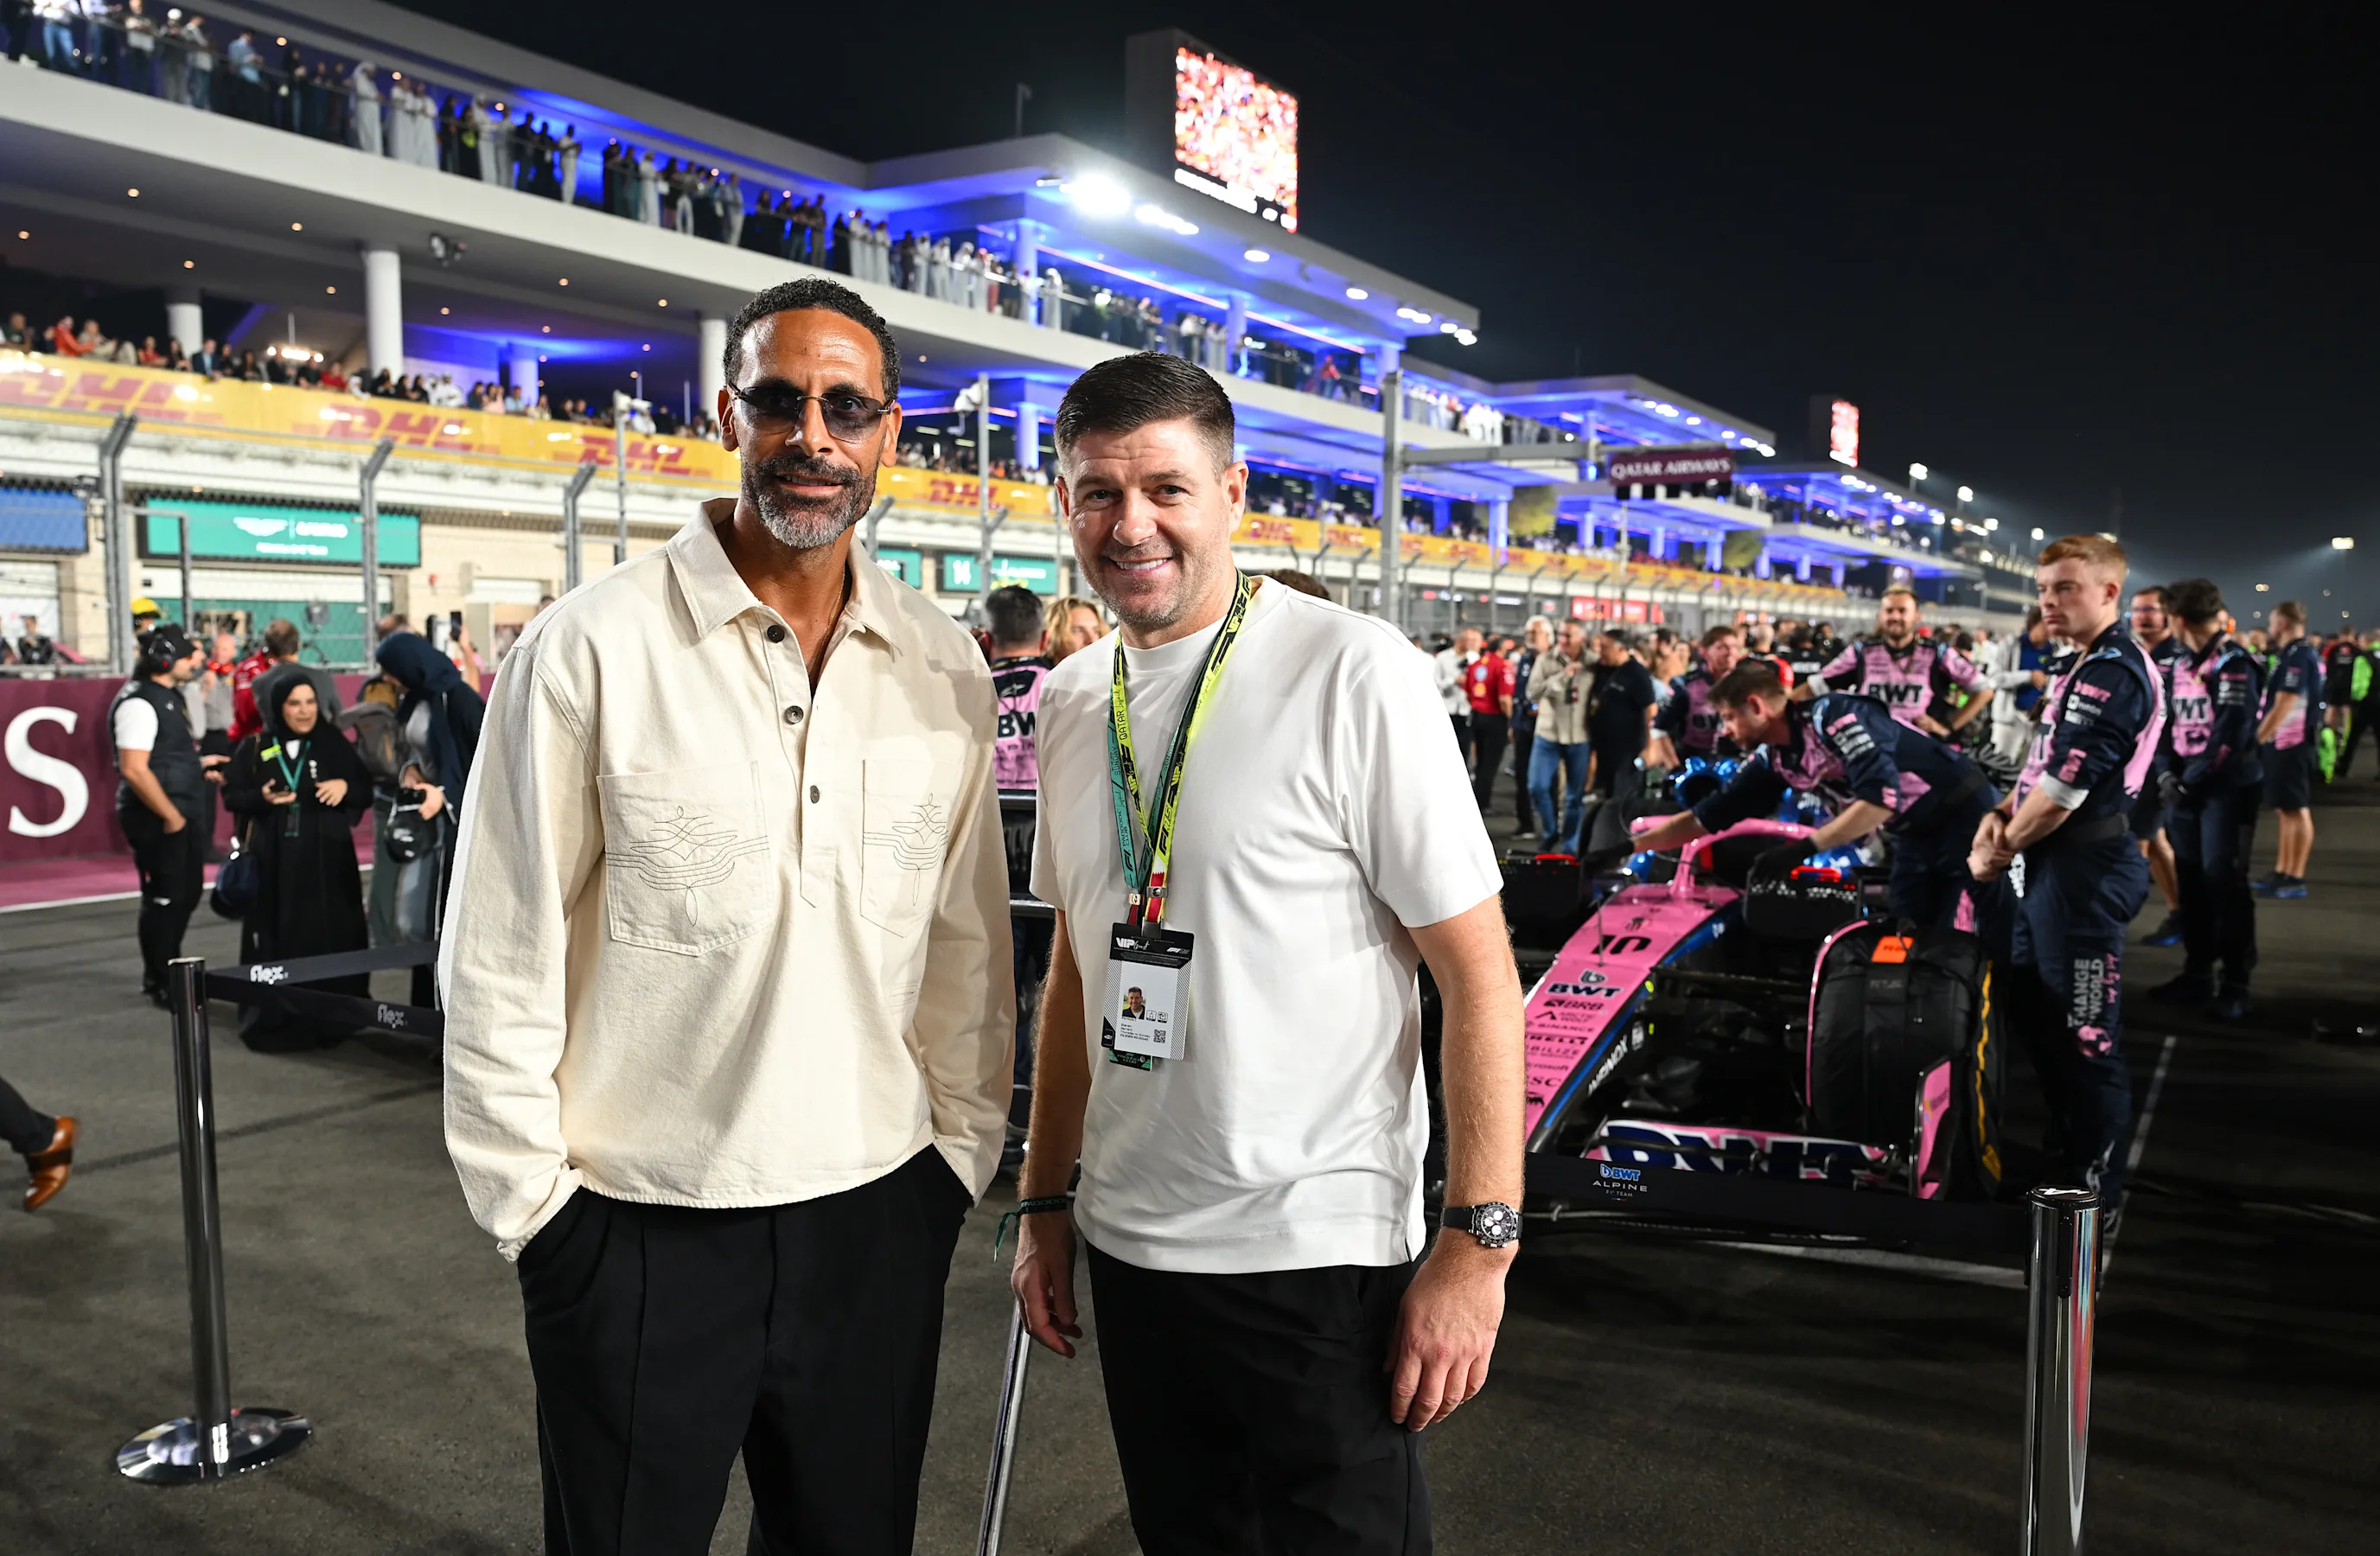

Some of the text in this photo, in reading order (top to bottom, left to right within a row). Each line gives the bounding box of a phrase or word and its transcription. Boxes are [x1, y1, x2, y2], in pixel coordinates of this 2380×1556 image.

[578, 435, 692, 475] DHL
[1611, 457, 1732, 480] QATAR AIRWAYS
[998, 710, 1036, 737] BW
[1116, 710, 1128, 741] QATAR
[4, 706, 89, 838] S
[1171, 766, 1181, 787] VIP
[1127, 775, 1139, 796] VIP
[1116, 937, 1135, 948] VIP
[1547, 982, 1621, 998] BWT
[1530, 1045, 1579, 1055] BILIZE
[1529, 1075, 1562, 1087] SC
[1611, 1167, 1641, 1182] BWT
[1592, 1180, 1648, 1192] ALPINE
